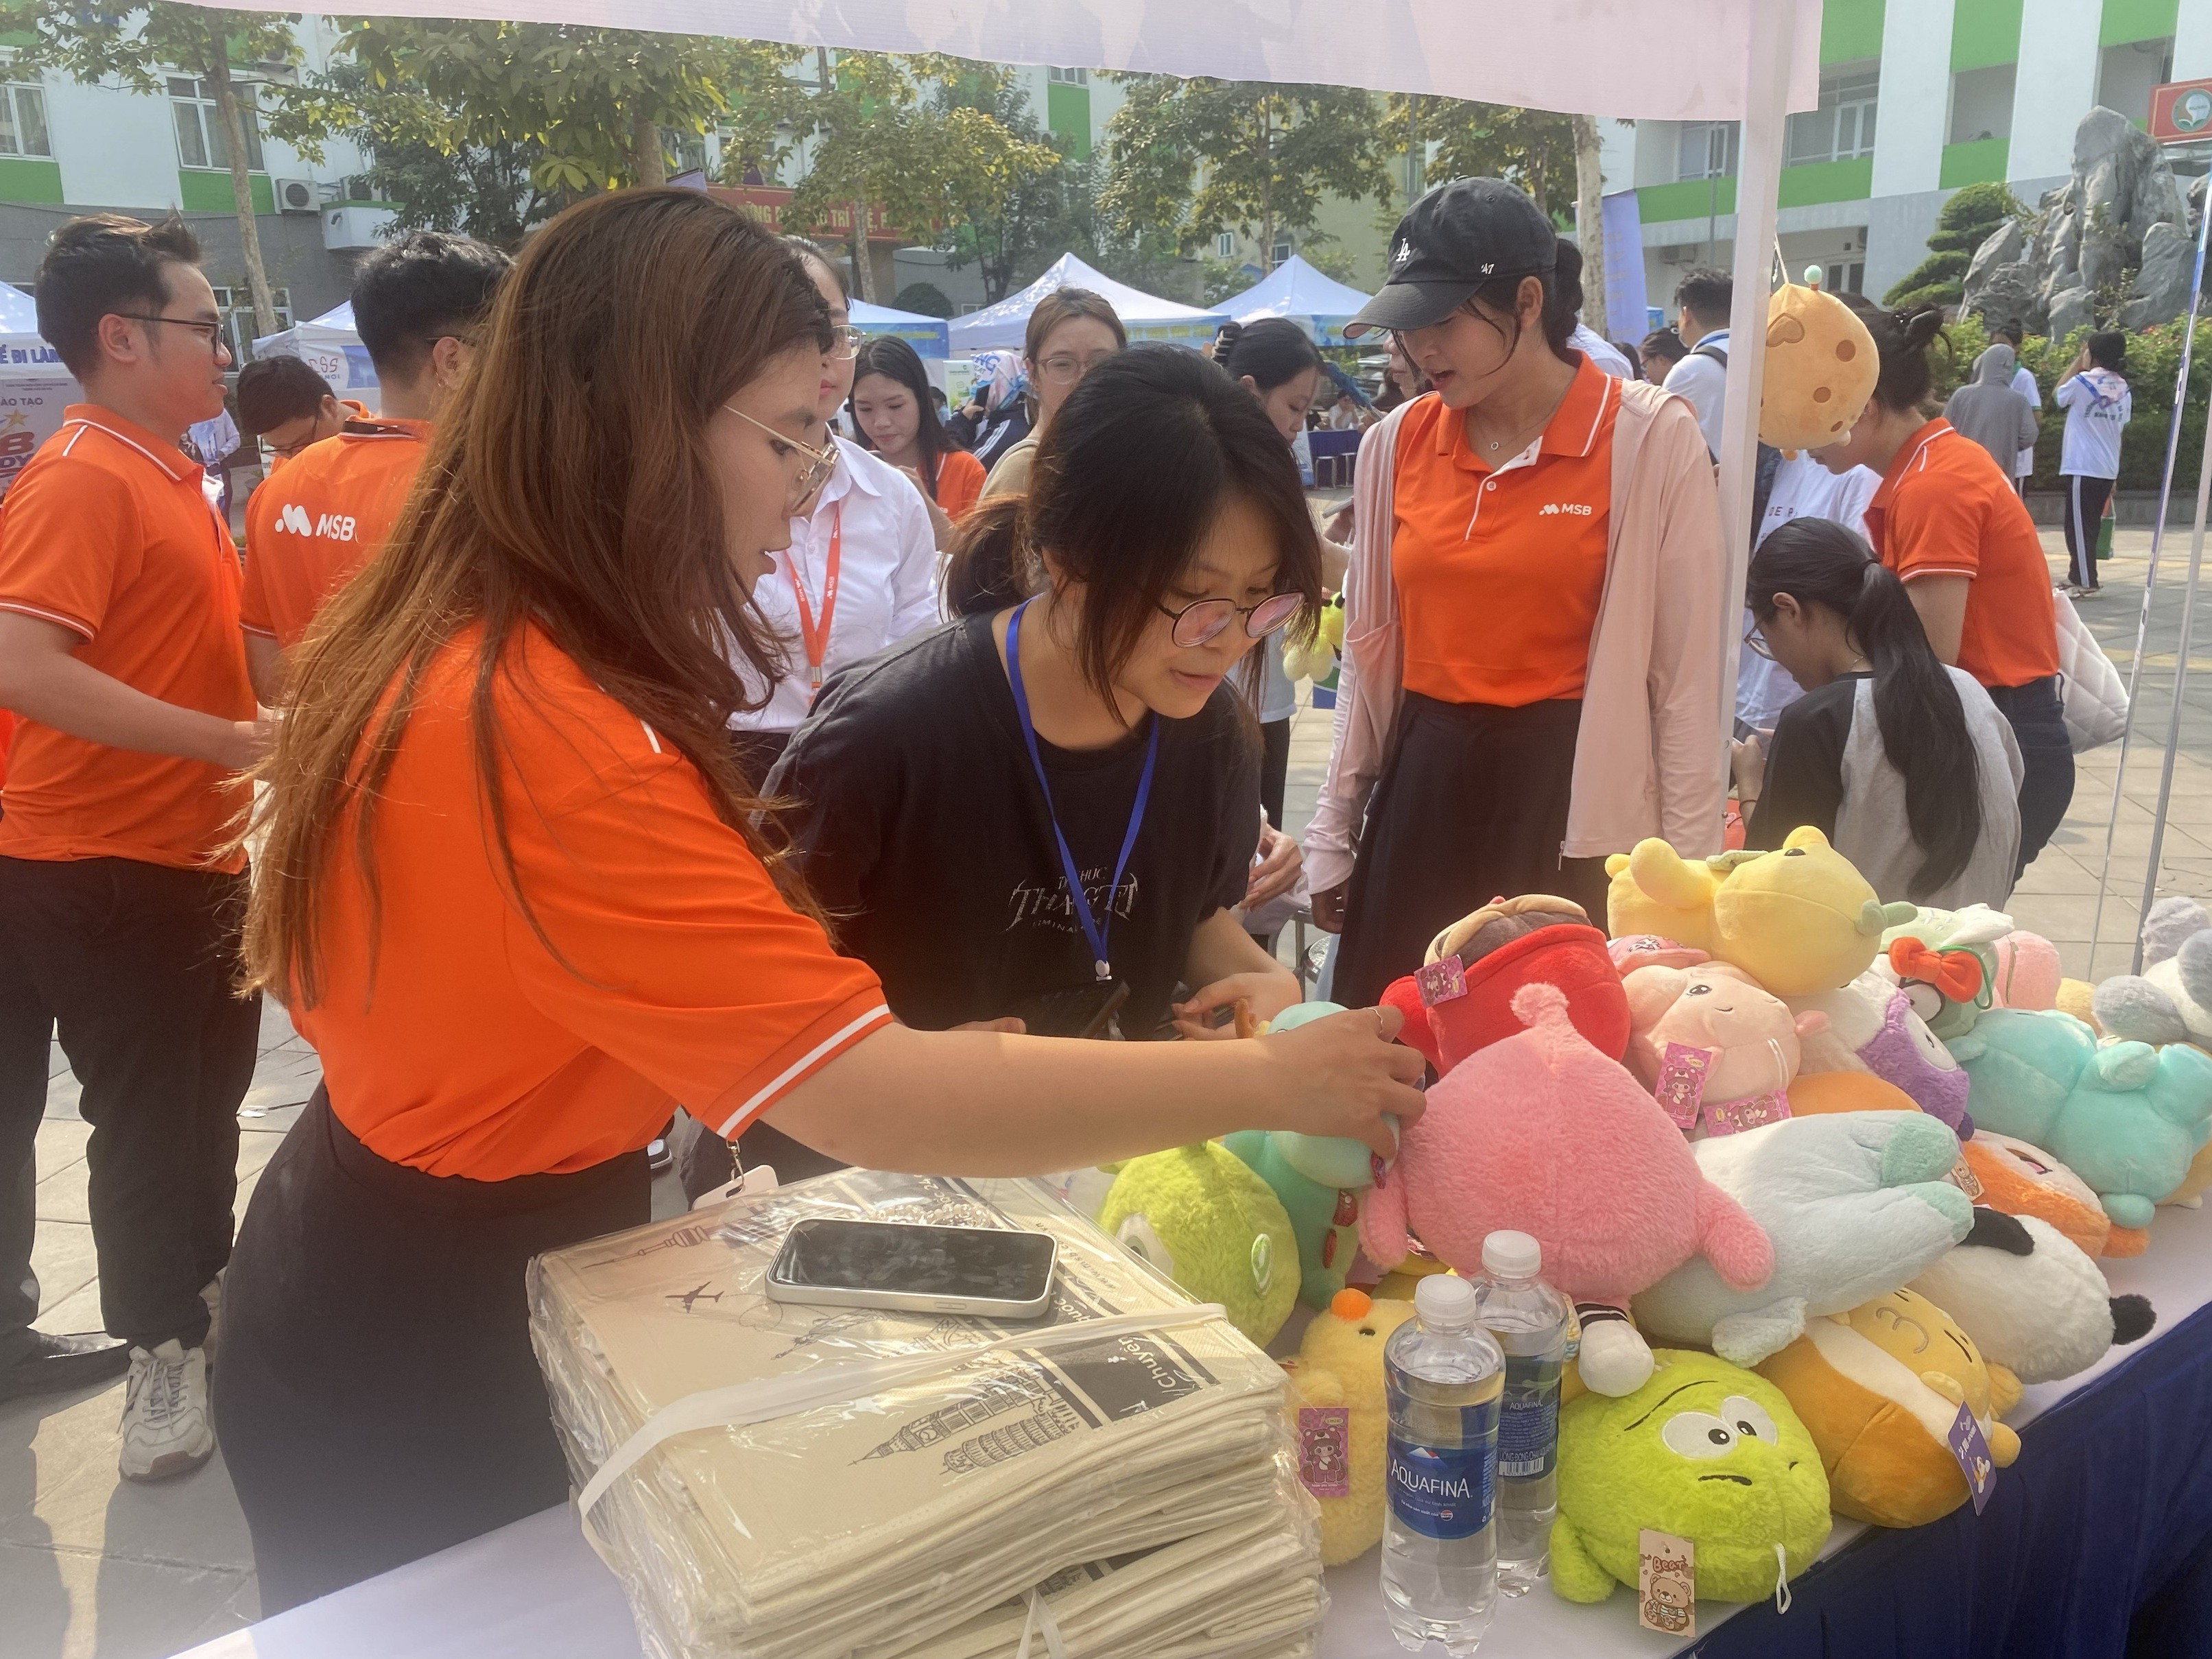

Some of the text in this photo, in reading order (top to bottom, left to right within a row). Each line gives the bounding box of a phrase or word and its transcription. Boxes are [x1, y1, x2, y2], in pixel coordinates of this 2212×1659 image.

[1396, 238, 1410, 261] LA
[0, 396, 43, 407] ÀO TẠO
[1561, 503, 1592, 516] MSB
[316, 514, 356, 542] MSB
[1510, 1400, 1542, 1411] AQUAFINA
[1391, 1459, 1471, 1499] AQUAFINA
[1652, 1556, 1687, 1573] Bear
